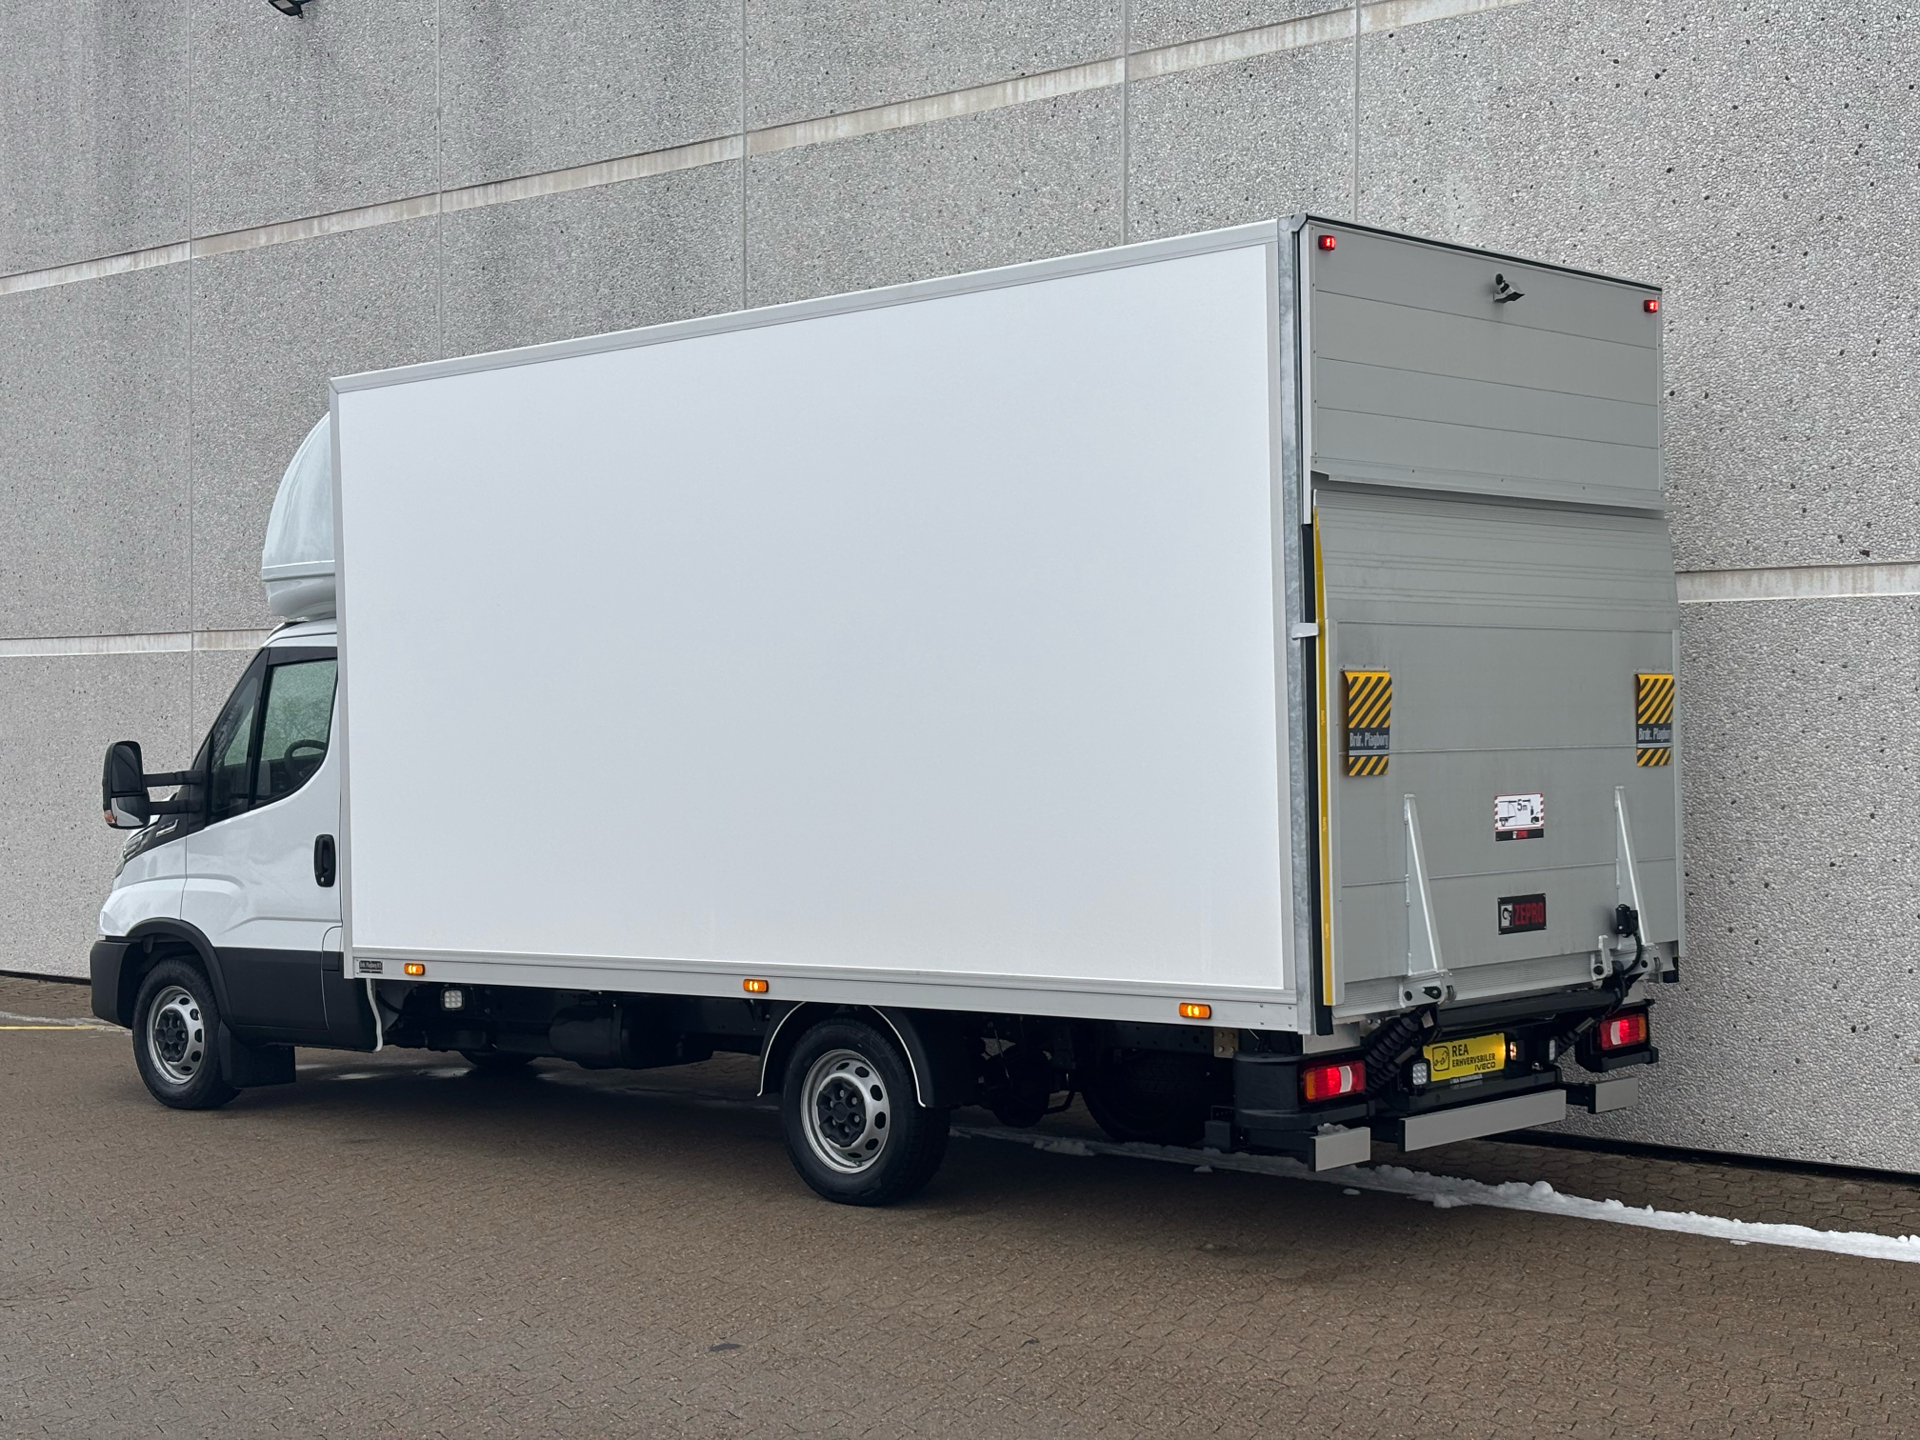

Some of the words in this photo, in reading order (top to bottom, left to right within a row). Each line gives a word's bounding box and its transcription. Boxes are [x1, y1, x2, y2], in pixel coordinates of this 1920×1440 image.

[1349, 732, 1364, 747] Brdr.
[1365, 731, 1389, 749] Plagborg
[1514, 902, 1544, 925] ZEPRO
[1452, 1044, 1469, 1057] REA
[1452, 1053, 1496, 1068] ERHVERVSBILER
[1474, 1062, 1496, 1071] IVECO
